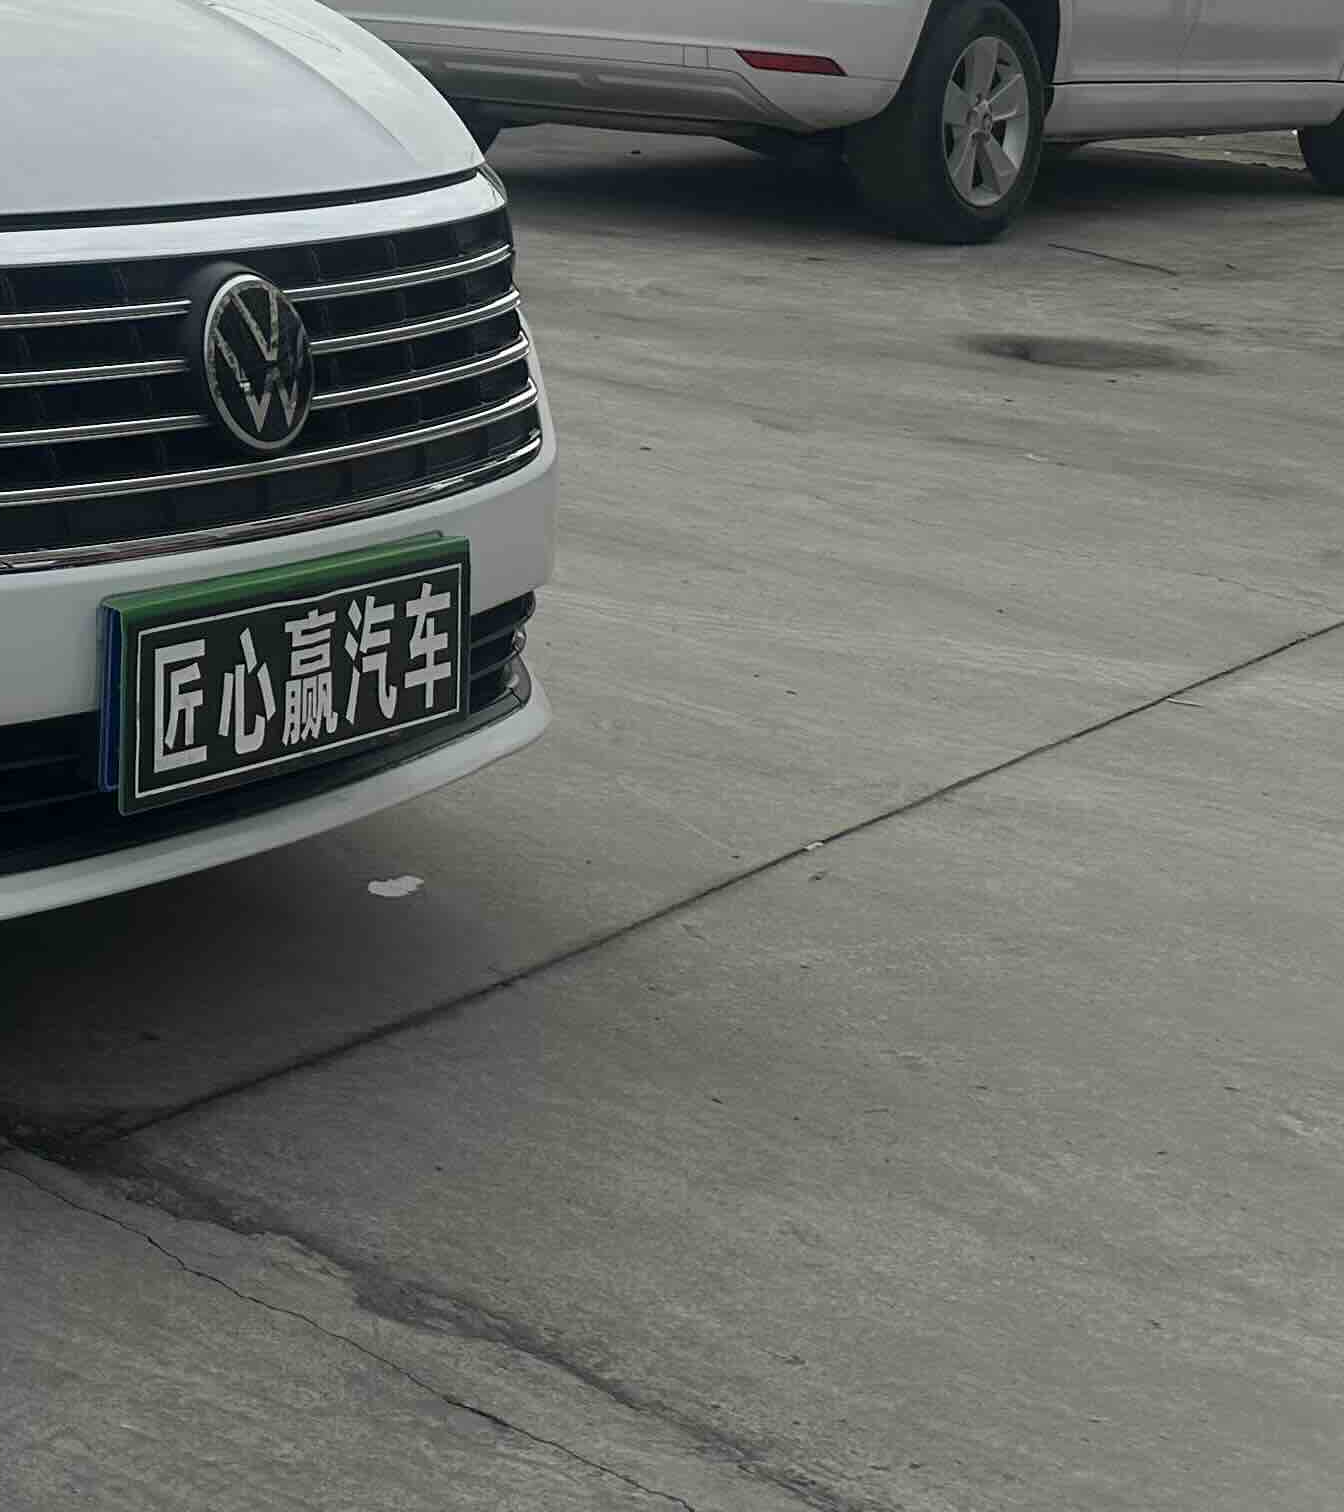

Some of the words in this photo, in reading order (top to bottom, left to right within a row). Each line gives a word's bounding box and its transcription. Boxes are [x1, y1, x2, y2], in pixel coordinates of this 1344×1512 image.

[153, 581, 452, 774] 匠心赢汽车
